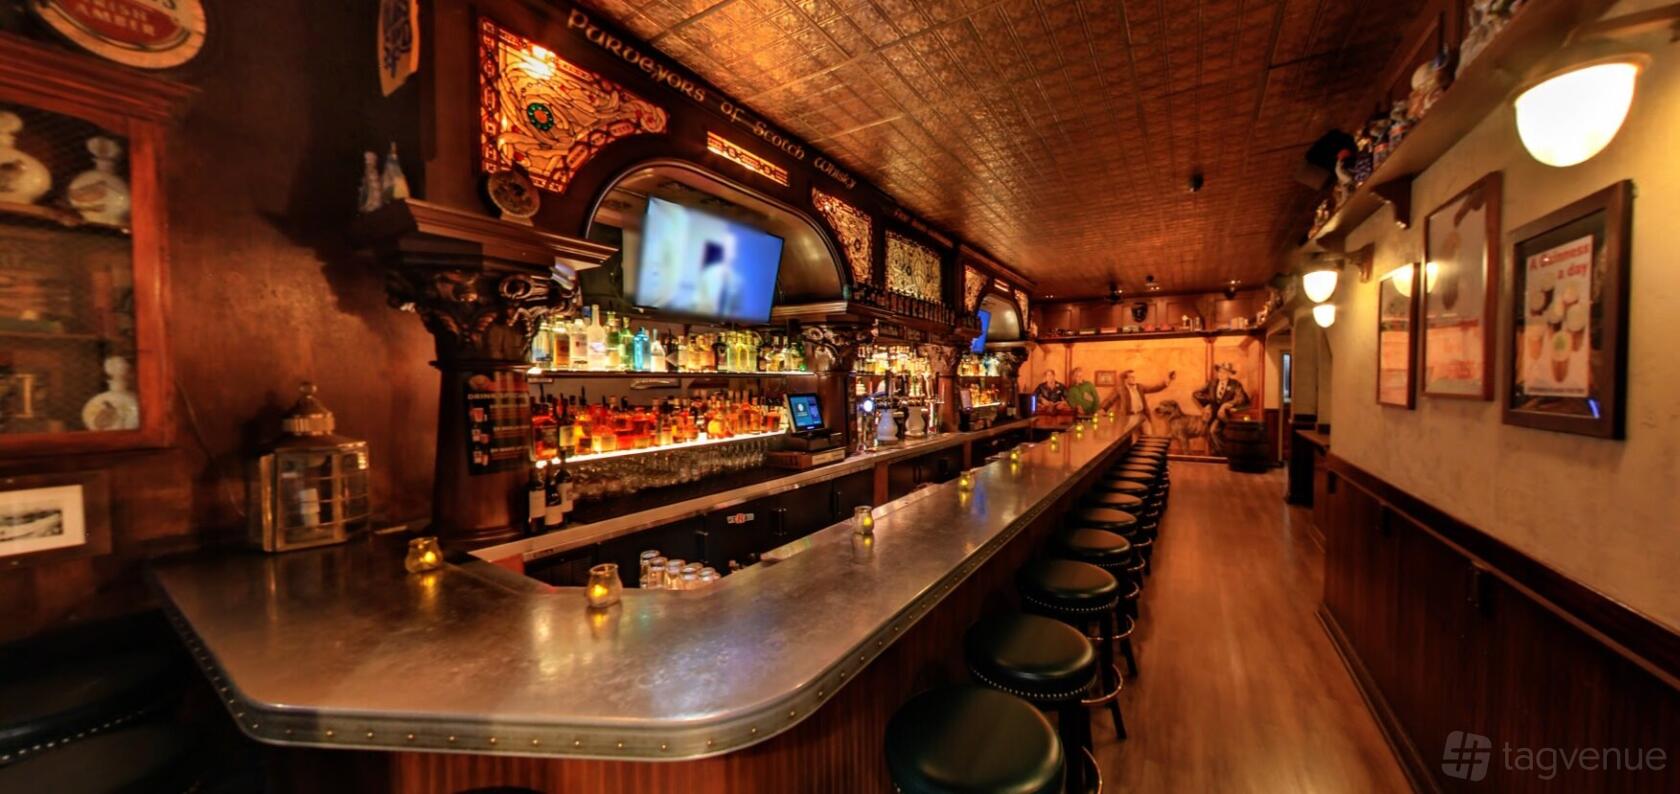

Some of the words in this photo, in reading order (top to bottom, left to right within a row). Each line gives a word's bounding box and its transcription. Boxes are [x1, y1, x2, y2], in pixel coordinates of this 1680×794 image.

[75, 3, 155, 37] AMBER
[720, 102, 745, 123] of
[753, 121, 805, 160] Scotch
[1529, 257, 1538, 272] A
[1566, 262, 1588, 278] day
